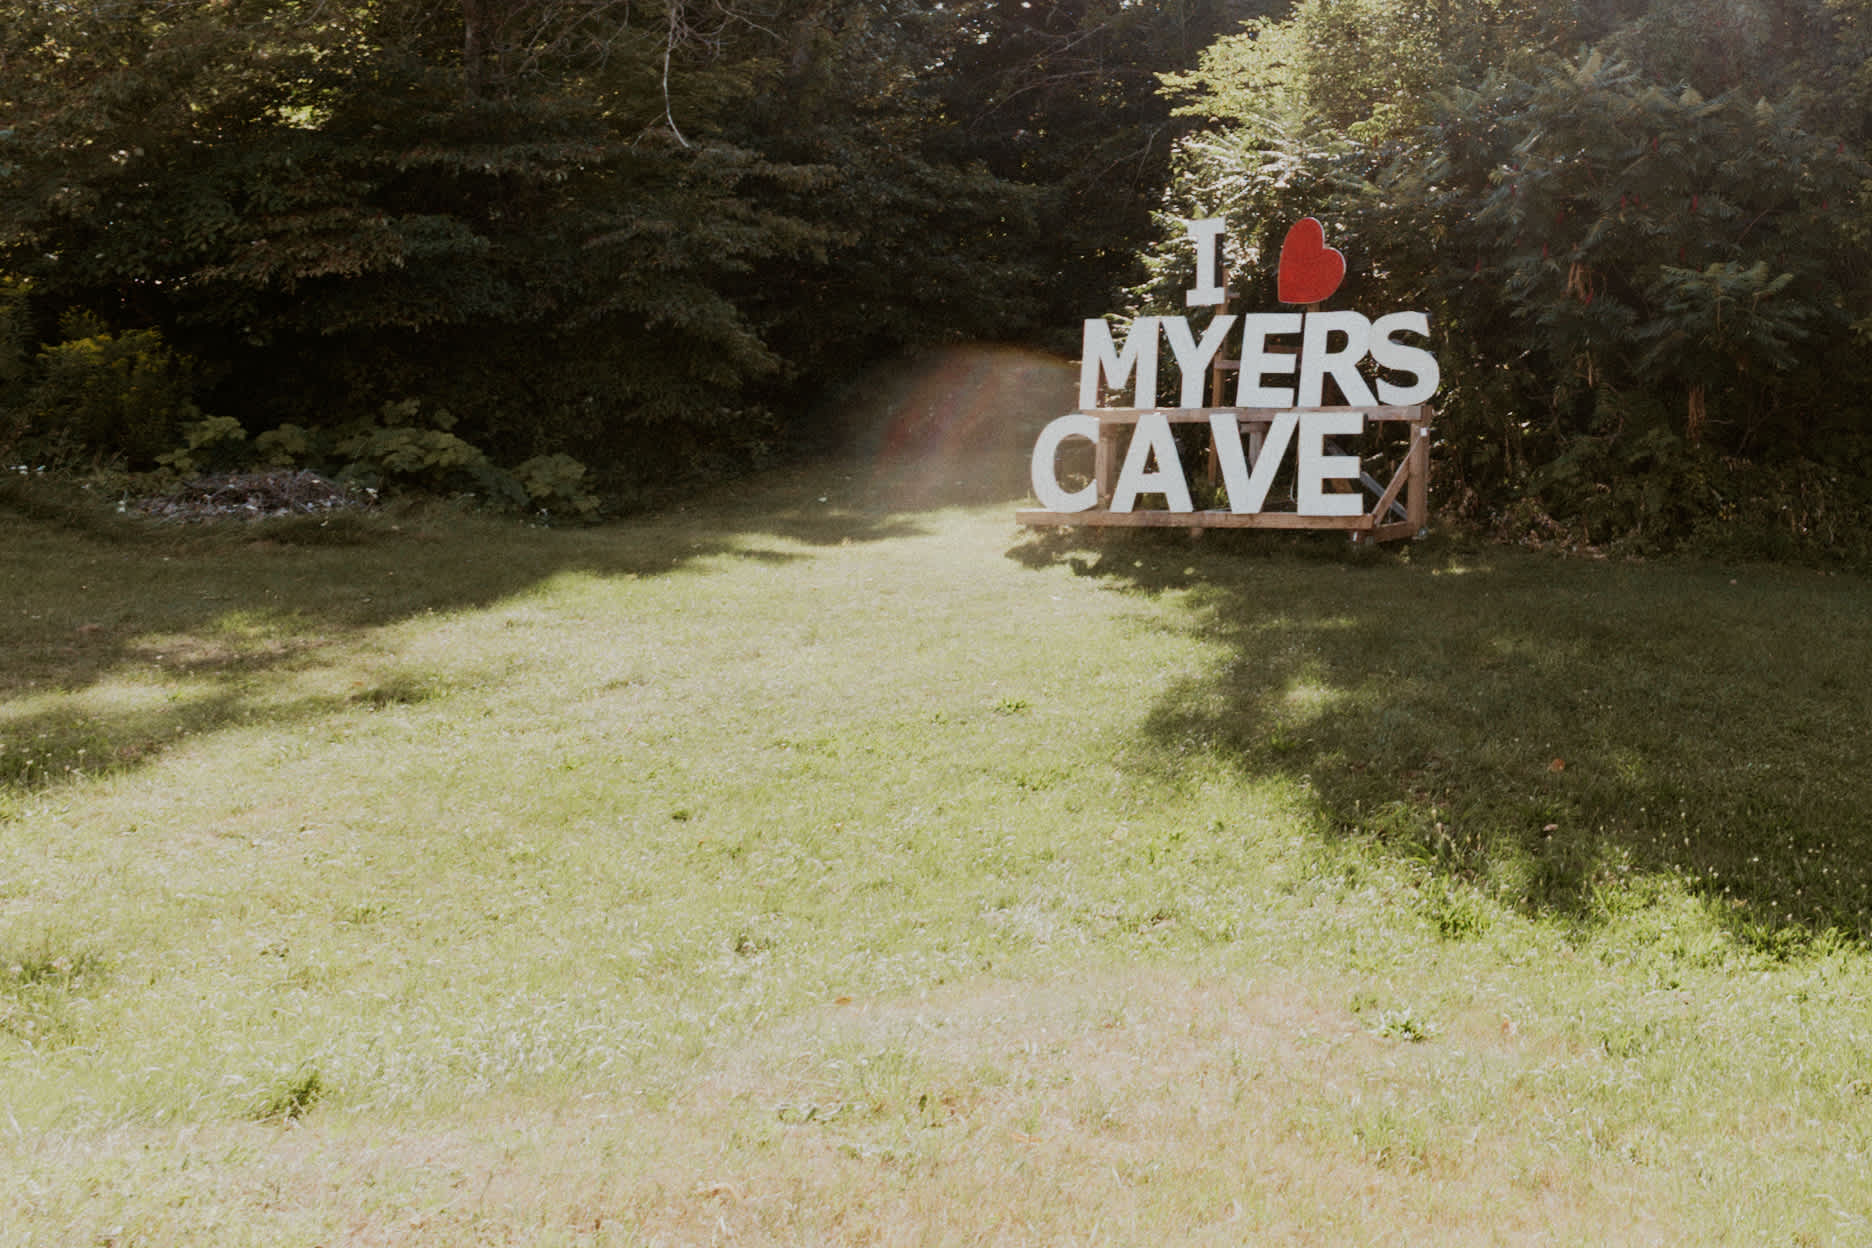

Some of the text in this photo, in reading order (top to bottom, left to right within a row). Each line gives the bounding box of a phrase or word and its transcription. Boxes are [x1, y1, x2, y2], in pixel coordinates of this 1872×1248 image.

[1186, 217, 1226, 306] I
[1078, 310, 1441, 410] MYERS
[1031, 412, 1366, 517] CAVE
